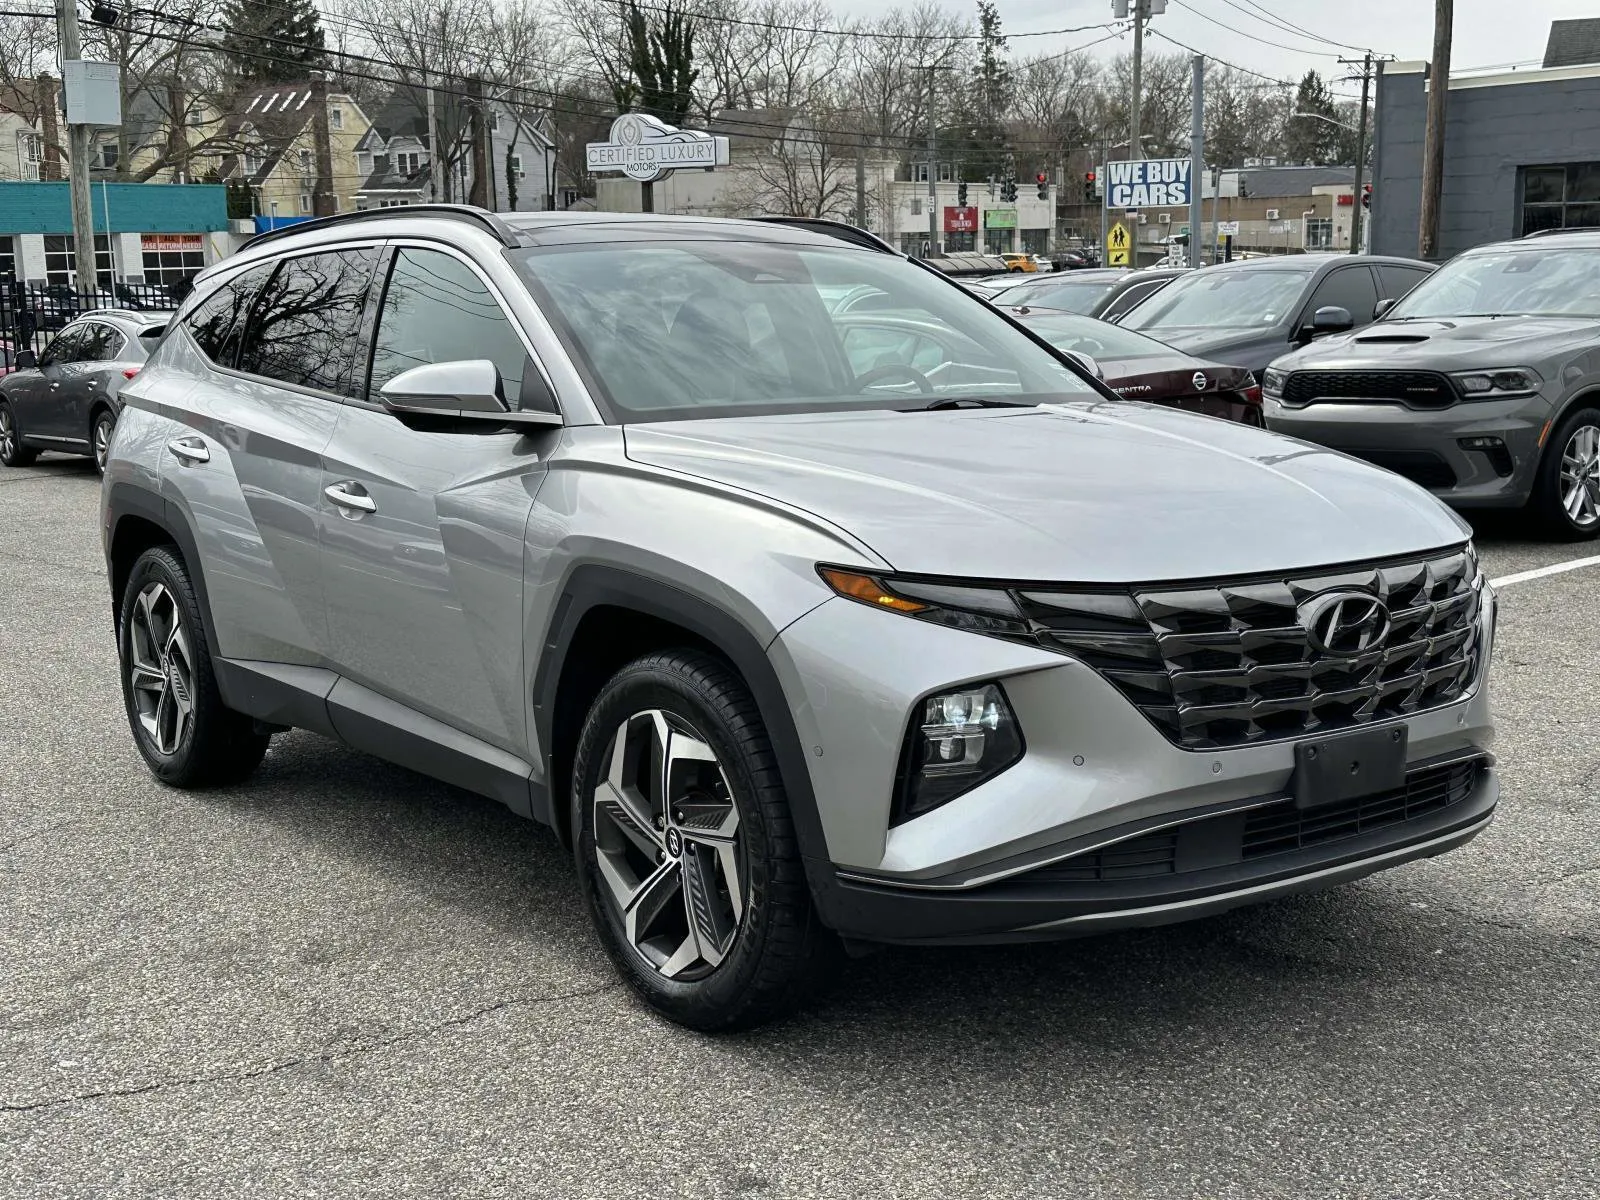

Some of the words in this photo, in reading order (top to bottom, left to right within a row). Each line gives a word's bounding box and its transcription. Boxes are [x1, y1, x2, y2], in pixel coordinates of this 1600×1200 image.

[588, 147, 655, 163] CERTIFIED
[660, 144, 713, 160] LUXURY
[626, 162, 656, 172] MOTORS
[1109, 163, 1143, 184] WE
[1147, 161, 1190, 183] BUY
[1112, 182, 1186, 207] CARS
